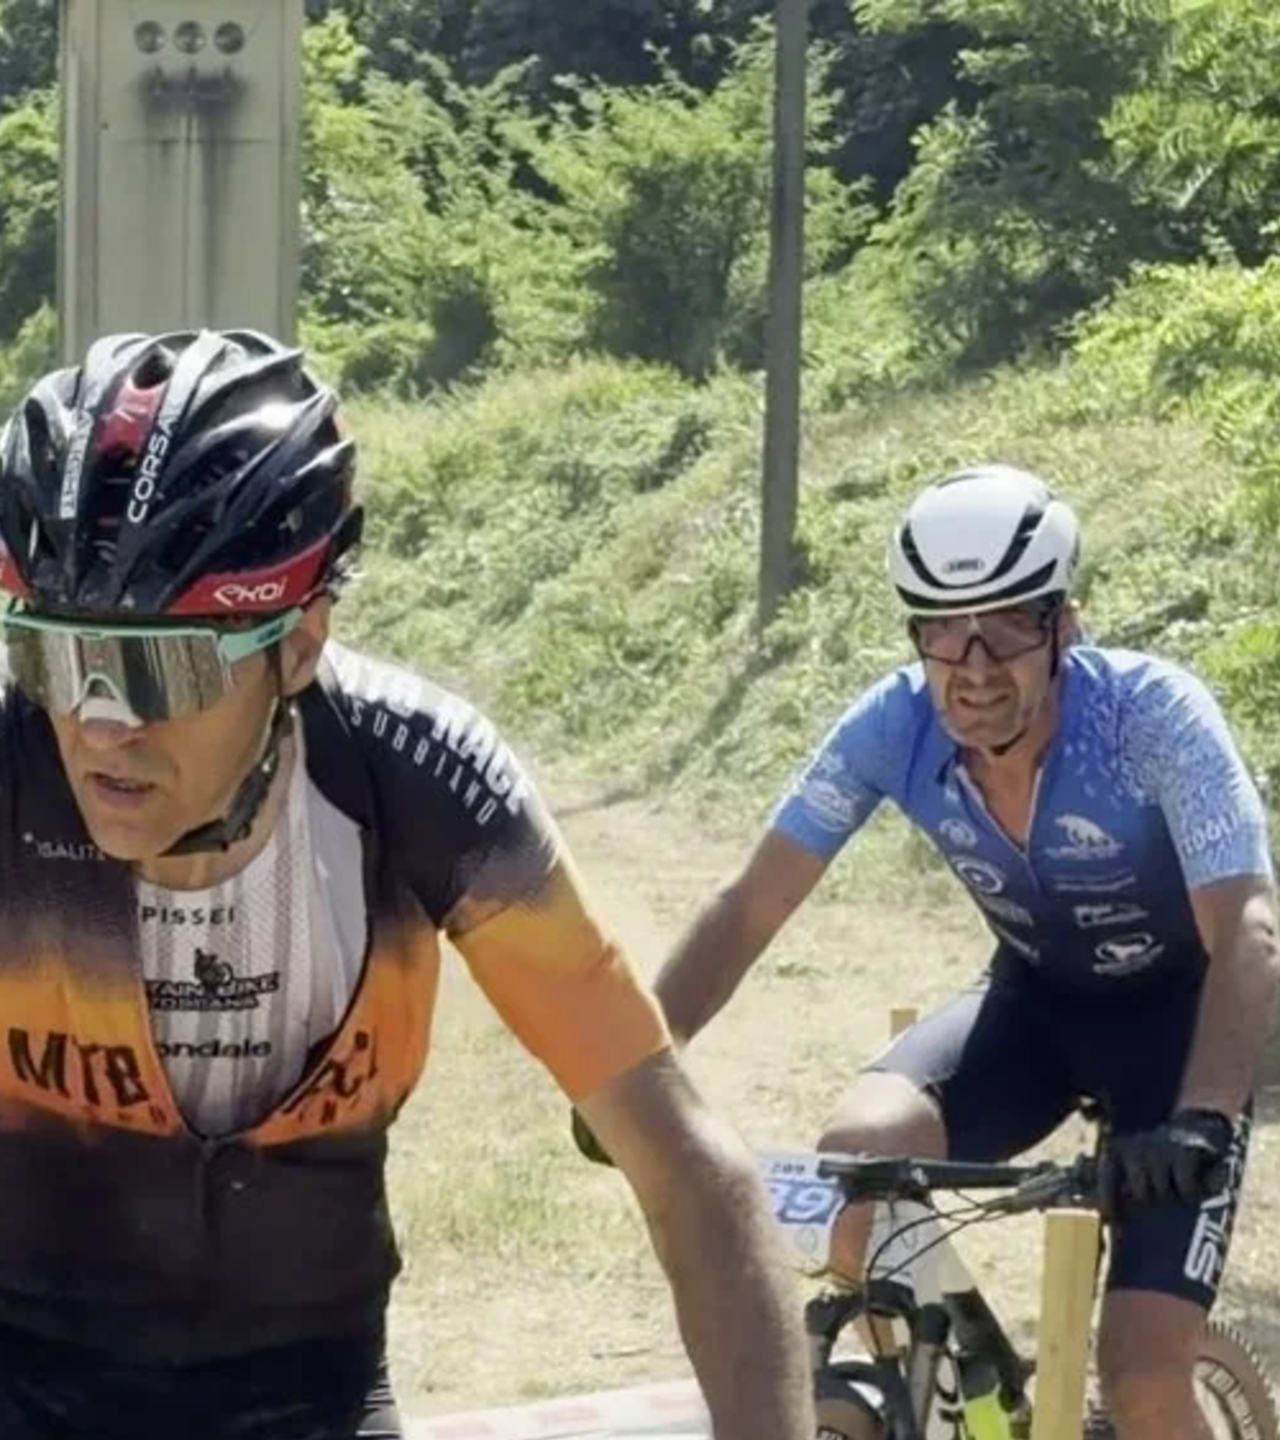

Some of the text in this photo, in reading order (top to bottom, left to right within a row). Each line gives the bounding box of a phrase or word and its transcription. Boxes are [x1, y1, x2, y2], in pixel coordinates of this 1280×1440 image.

[127, 414, 179, 524] CORSA
[351, 698, 498, 826] SUBBIANO
[142, 905, 235, 925] PISSEI
[8, 1027, 150, 1107] MTB
